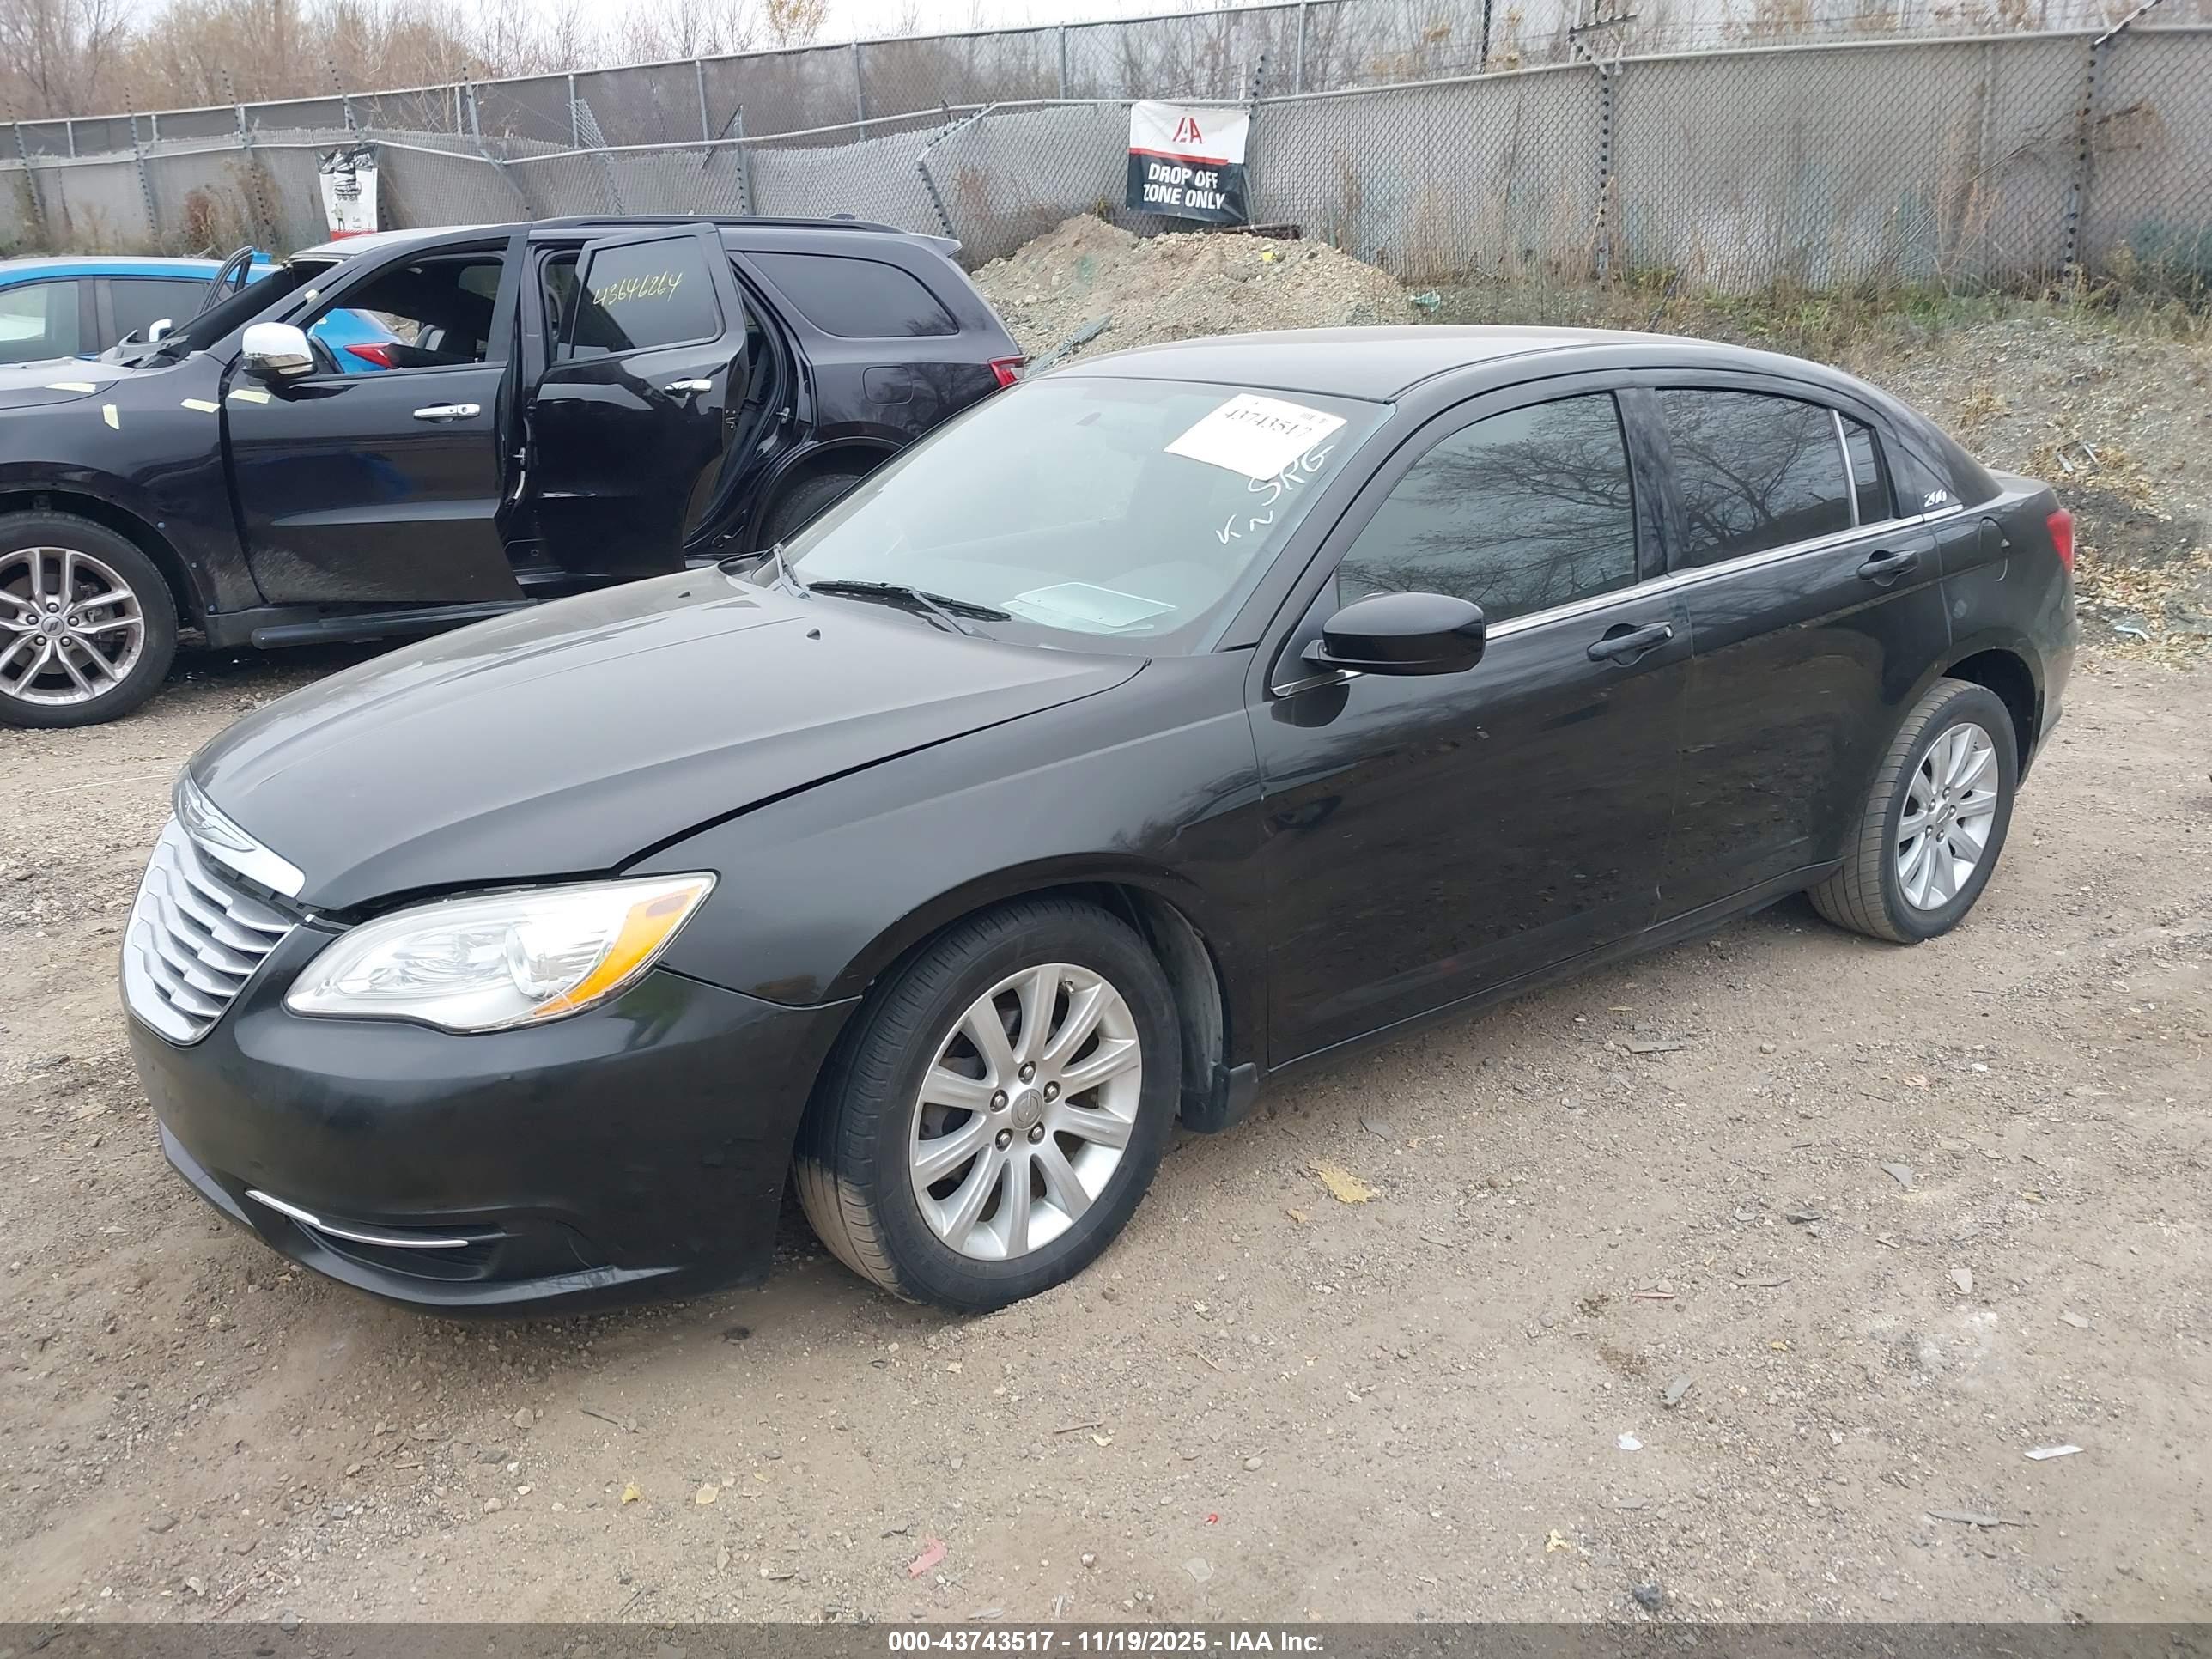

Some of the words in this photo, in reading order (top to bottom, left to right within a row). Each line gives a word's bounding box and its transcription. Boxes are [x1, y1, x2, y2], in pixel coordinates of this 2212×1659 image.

[1148, 162, 1193, 185] DROP
[1194, 170, 1218, 190] OFF
[1143, 183, 1182, 205] ZONE
[1185, 188, 1226, 210] ONLY
[592, 270, 684, 307] 43646264
